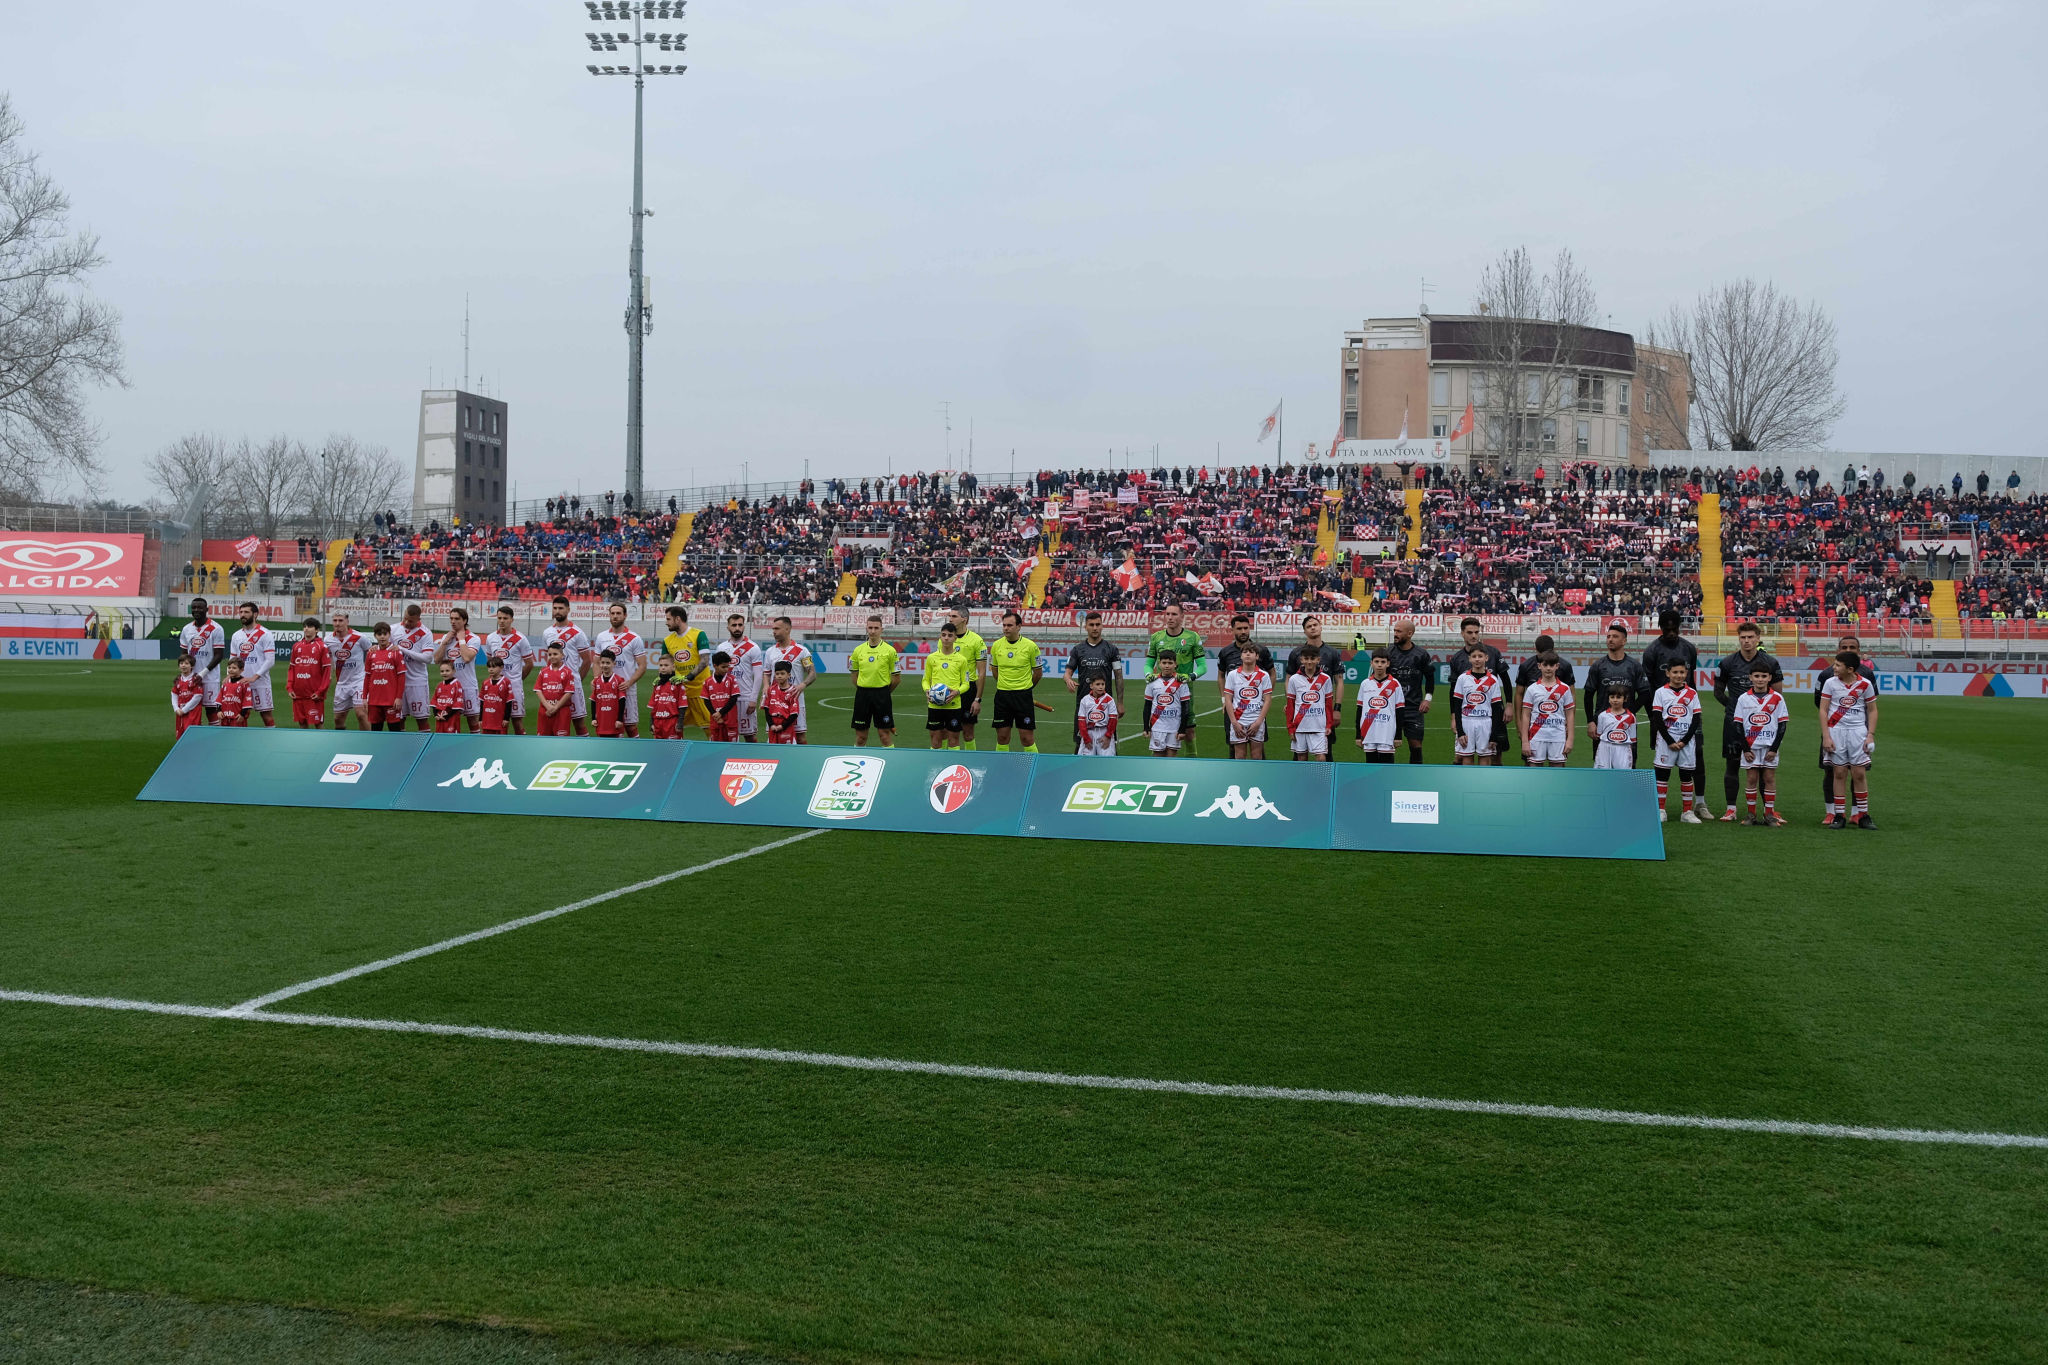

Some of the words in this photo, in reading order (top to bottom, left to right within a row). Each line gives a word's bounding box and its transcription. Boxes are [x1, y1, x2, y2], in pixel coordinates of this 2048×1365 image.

[1373, 447, 1425, 457] MANTOVA
[0, 575, 120, 589] LGIDA
[825, 613, 851, 625] MARCO
[1017, 610, 1072, 626] VECCHIA
[1101, 611, 1149, 627] UARDIA
[1257, 613, 1303, 625] GRAZIE
[9, 640, 20, 656] &
[24, 641, 79, 656] EVENTI
[207, 691, 214, 700] 7
[411, 702, 423, 712] 87
[1670, 707, 1685, 715] PATA
[740, 718, 751, 729] 21
[1745, 729, 1775, 739] Sinergy
[335, 765, 356, 773] PATA
[725, 763, 774, 771] MANTOVA
[538, 766, 636, 787] BKT
[831, 788, 858, 798] Serie
[1071, 787, 1180, 808] BKT
[816, 799, 866, 811] BKT
[1394, 801, 1436, 812] Sinergy
